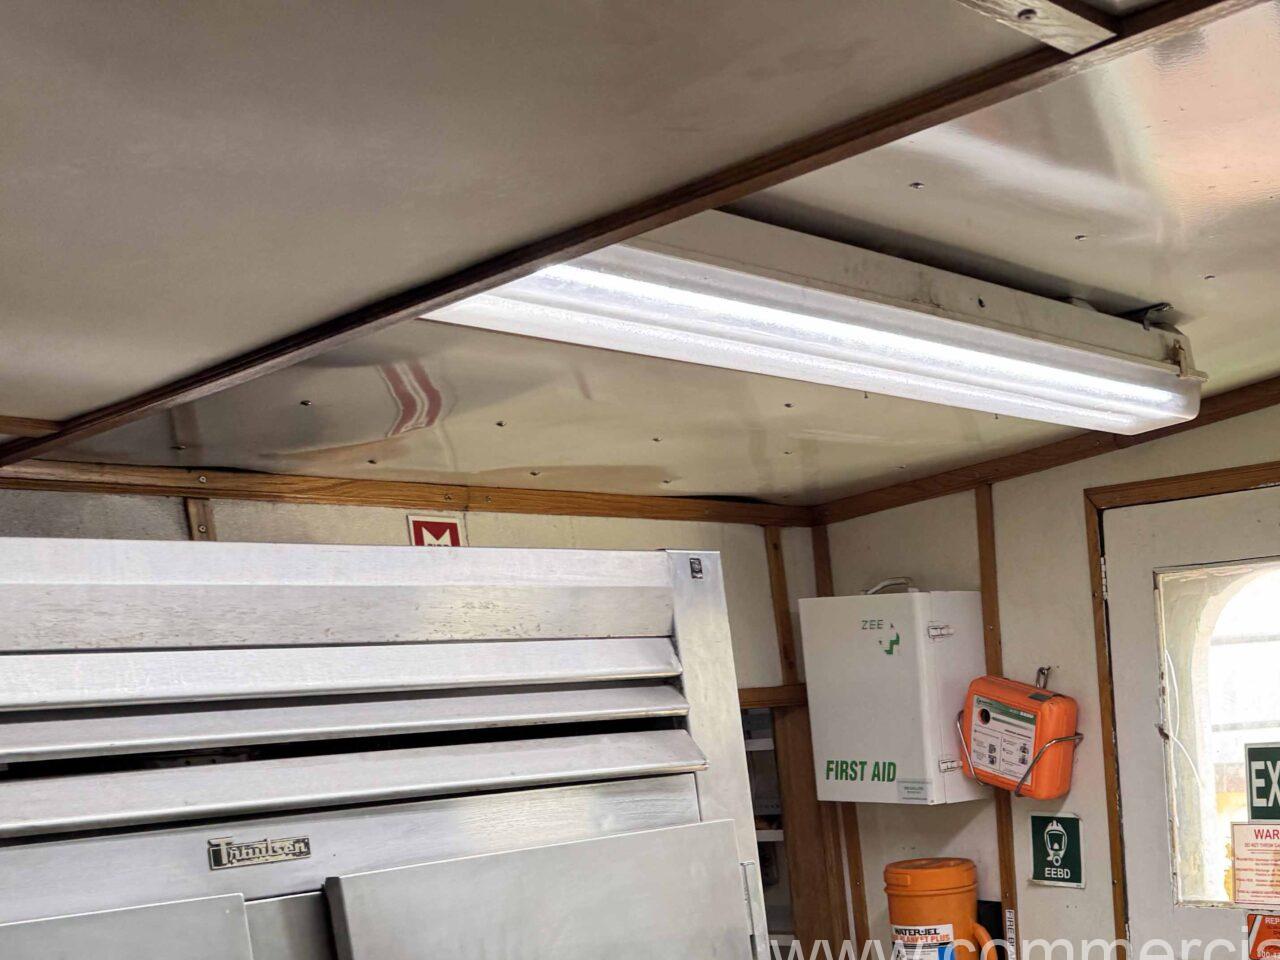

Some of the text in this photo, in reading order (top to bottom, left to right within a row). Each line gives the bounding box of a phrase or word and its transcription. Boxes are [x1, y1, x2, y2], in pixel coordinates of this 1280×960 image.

[861, 619, 884, 630] ZEE
[825, 760, 897, 782] FIRST AID
[208, 837, 309, 865] Traulsen
[1044, 867, 1071, 879] EEBD
